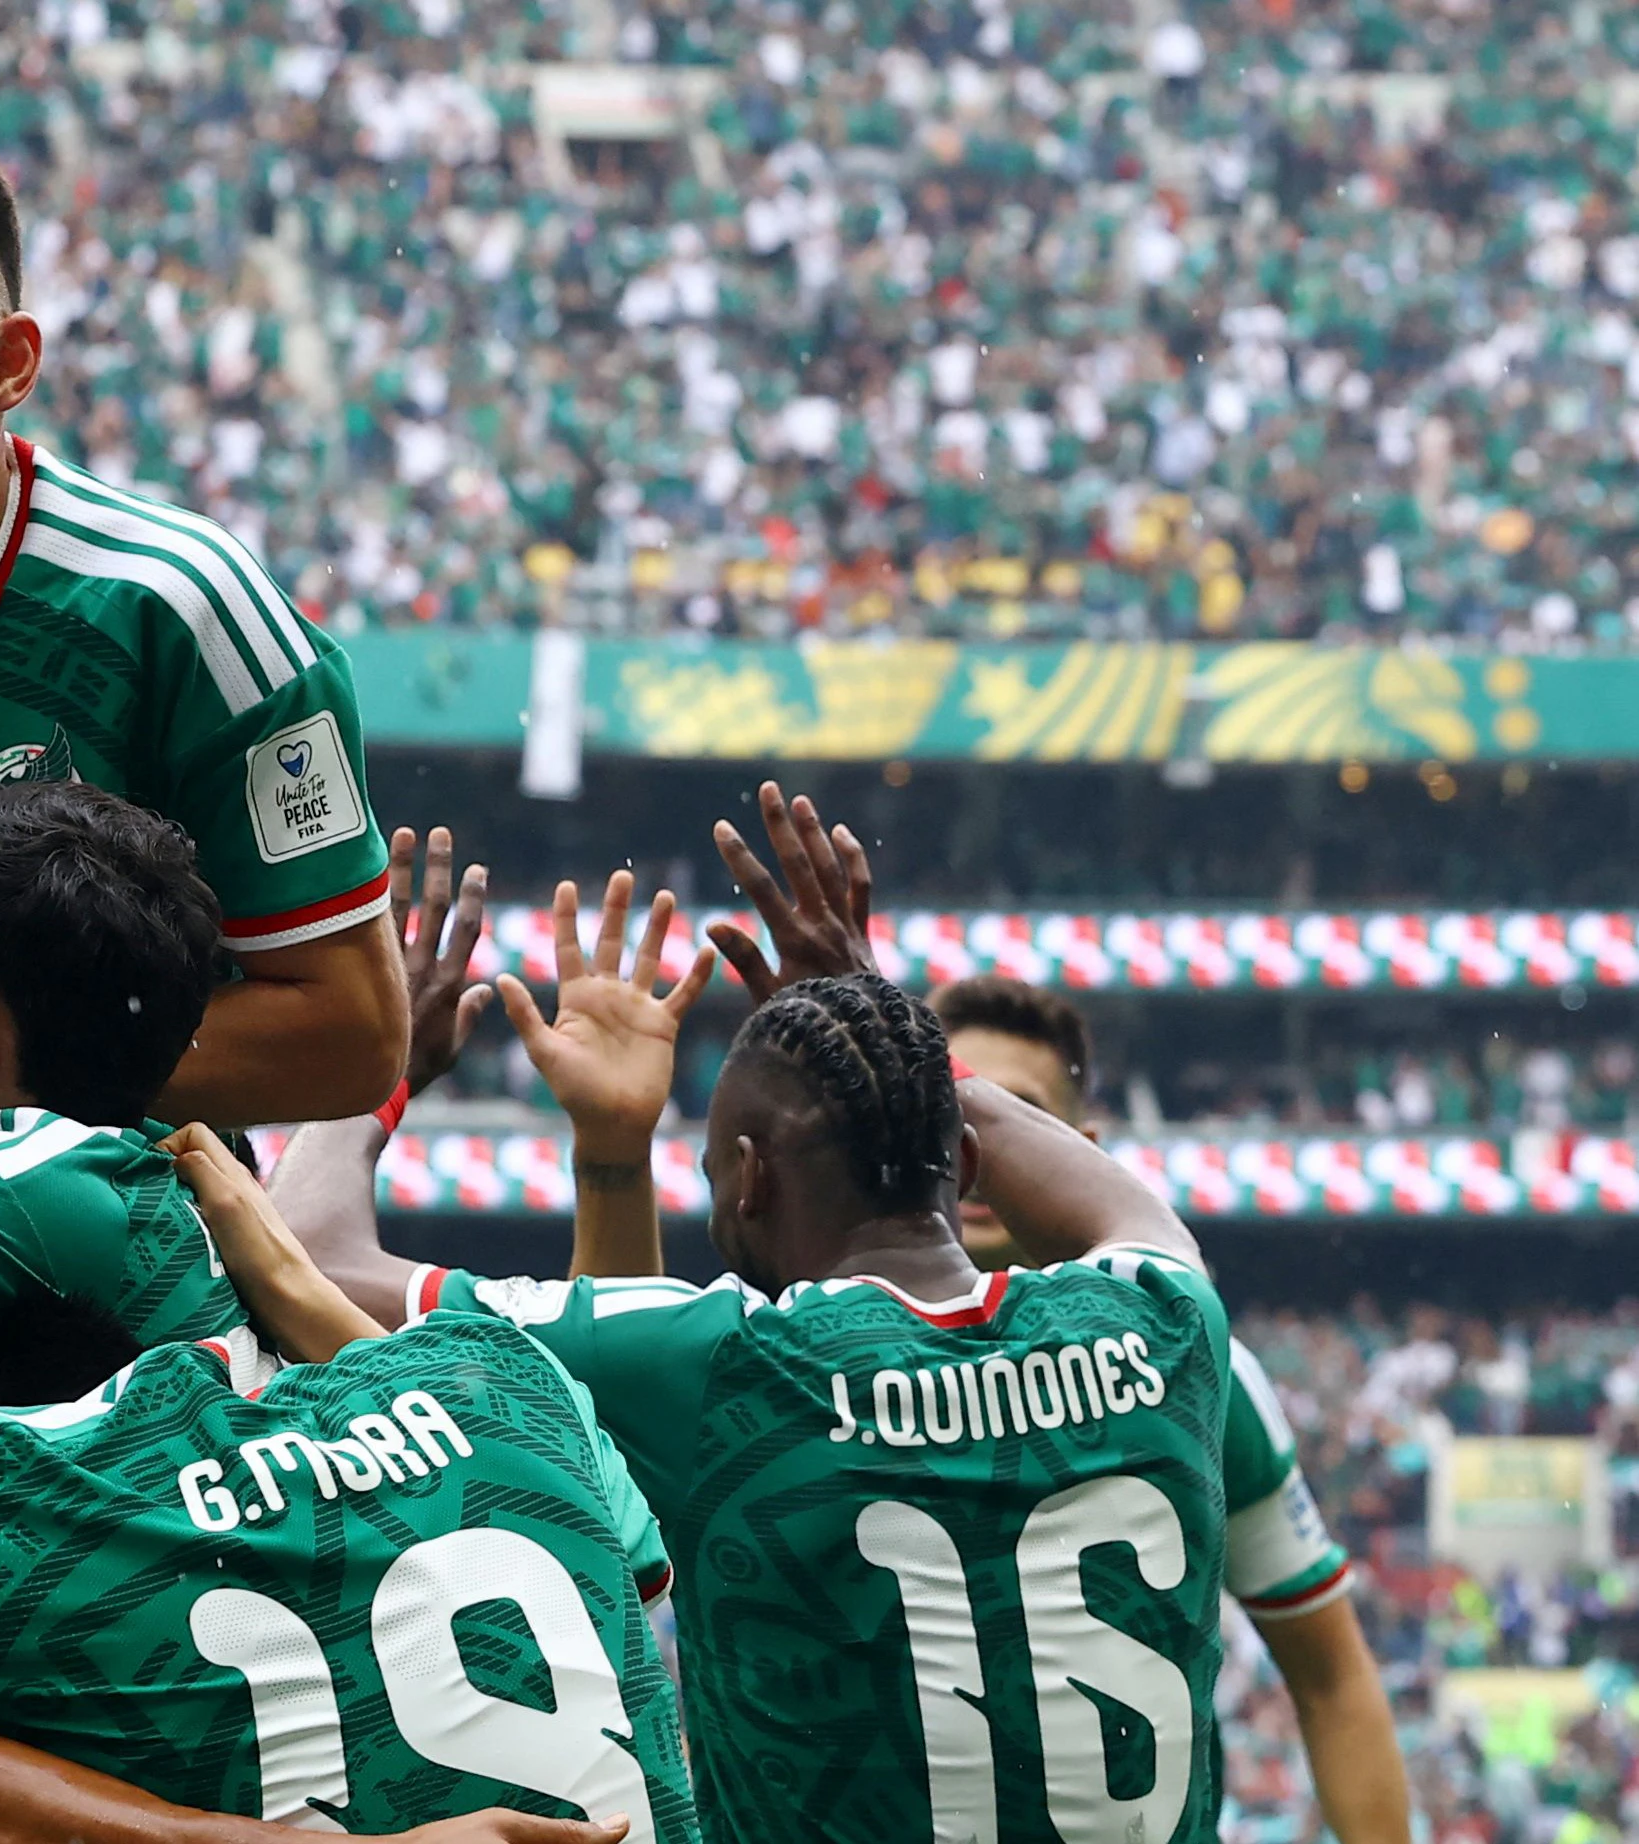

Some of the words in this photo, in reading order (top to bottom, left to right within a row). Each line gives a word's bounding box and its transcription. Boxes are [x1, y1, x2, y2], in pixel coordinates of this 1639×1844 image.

[276, 782, 309, 808] Unite
[308, 773, 327, 797] For
[284, 795, 331, 828] PEACE
[298, 822, 325, 839] FIFA
[829, 1332, 1165, 1446] J.QUIÑONES
[178, 1390, 474, 1532] G.MORA
[189, 1527, 657, 1844] 19
[856, 1475, 1193, 1844] 16
